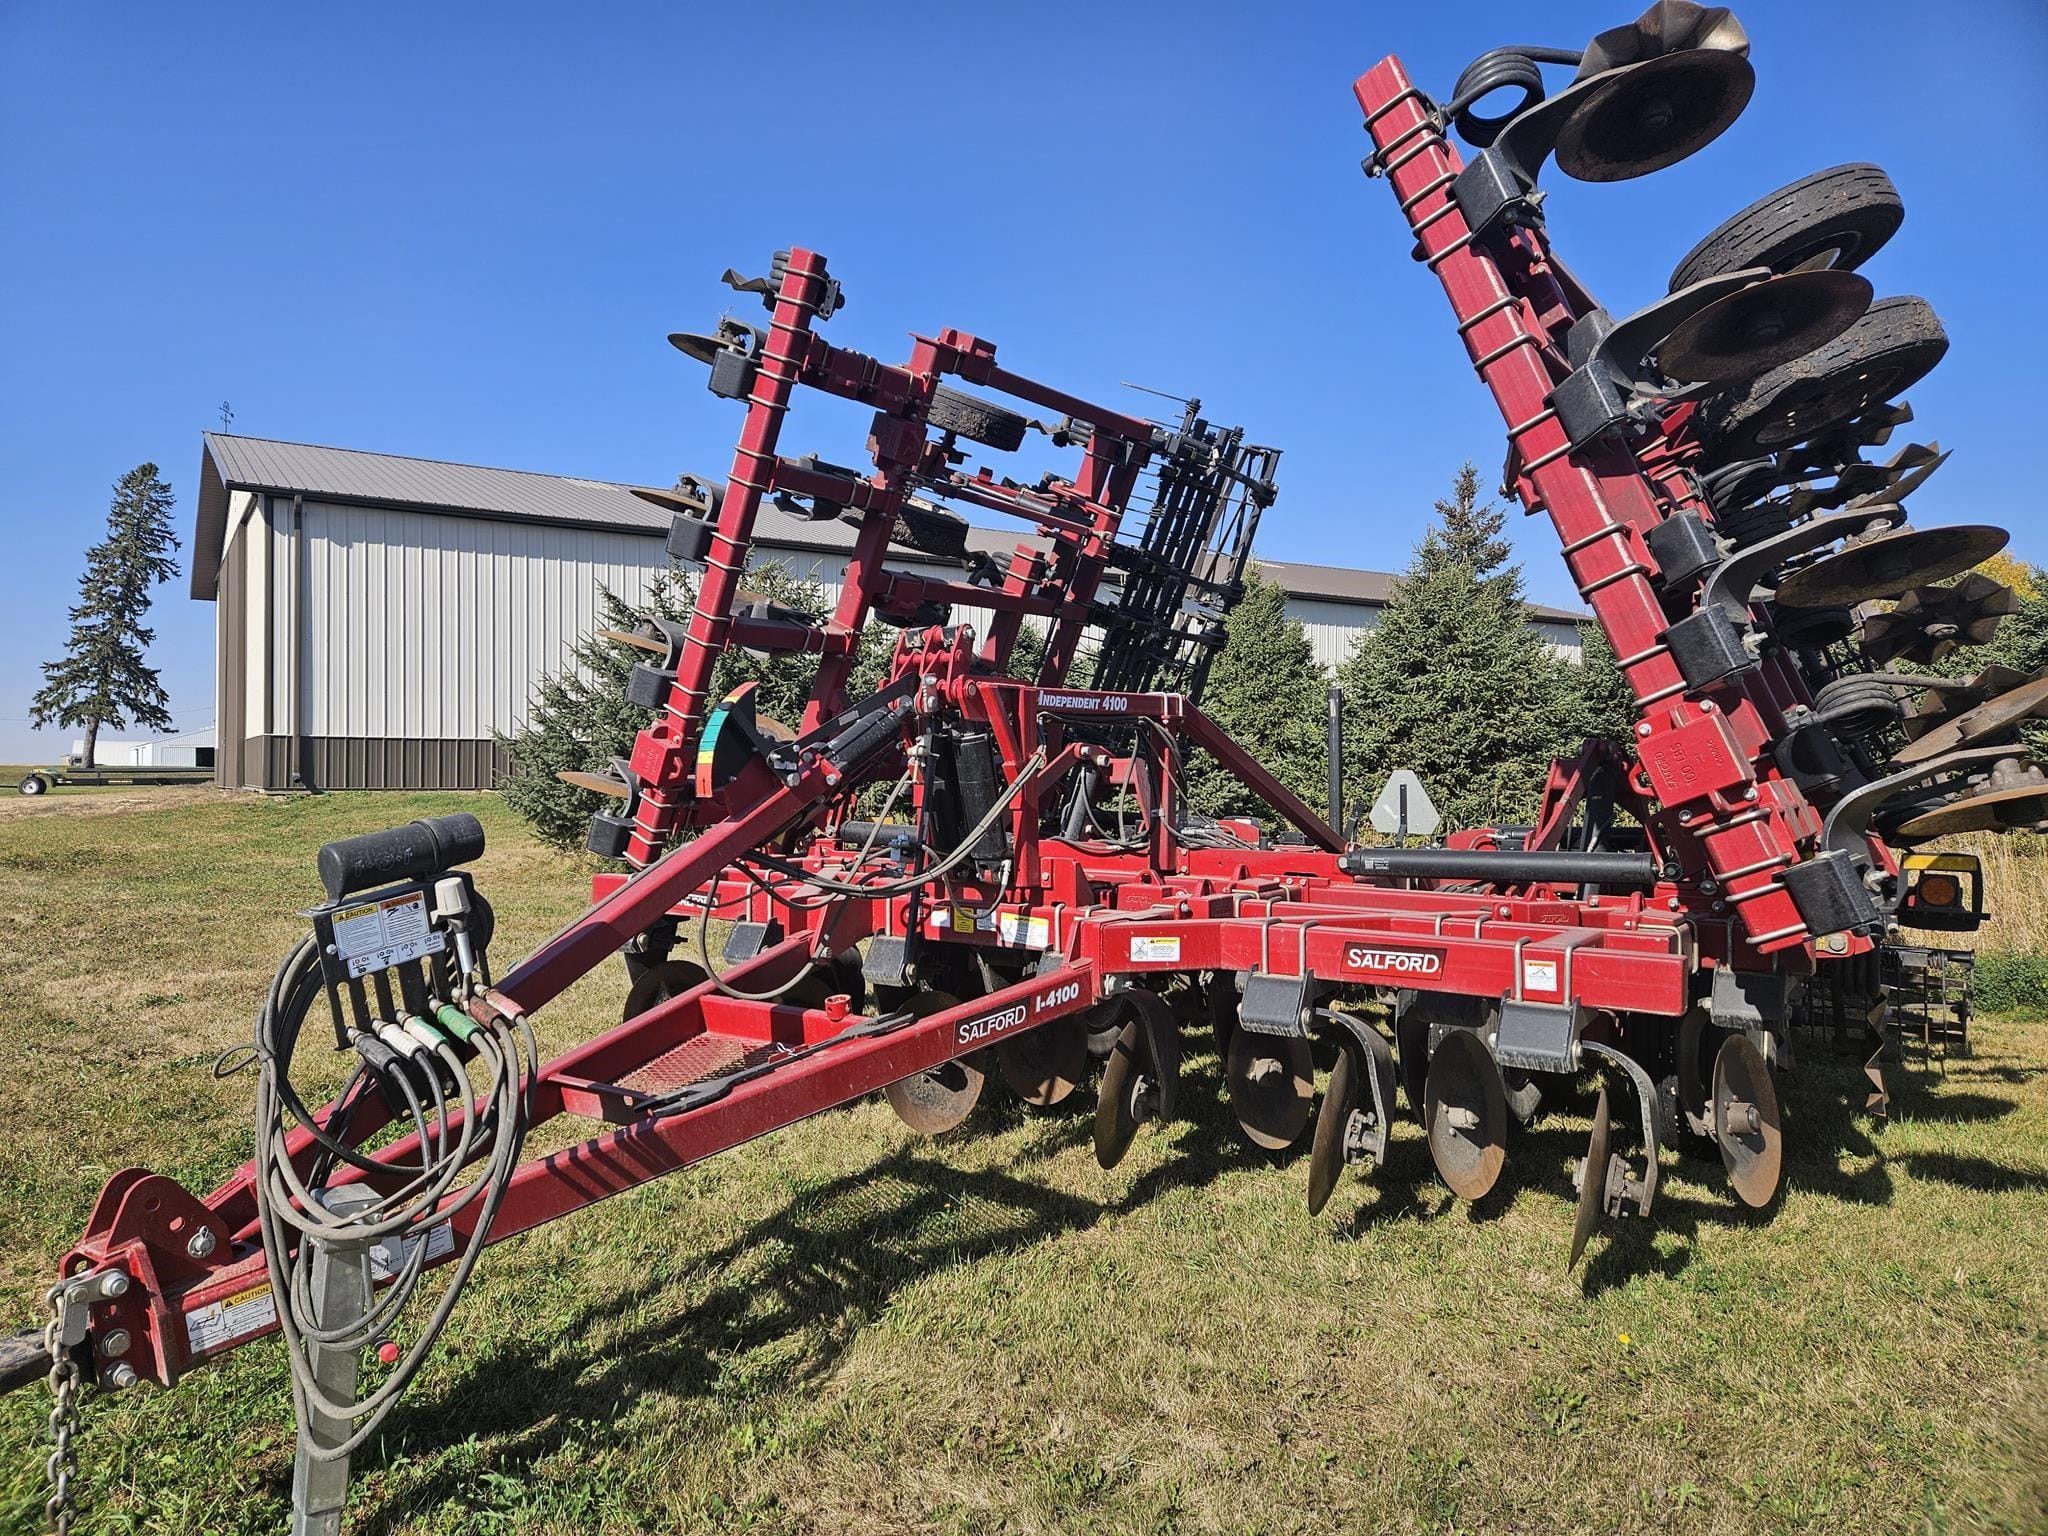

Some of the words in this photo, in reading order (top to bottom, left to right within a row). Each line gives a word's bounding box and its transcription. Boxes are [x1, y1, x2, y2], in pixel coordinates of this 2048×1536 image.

[1038, 690, 1101, 710] INDEPENDENT
[1102, 695, 1128, 712] 4100
[345, 906, 374, 920] CAUTION
[1347, 948, 1440, 974] SALFORD
[958, 1004, 1027, 1045] SALFORD
[1035, 982, 1080, 1014] I-4100
[234, 1286, 270, 1304] CAUTION
